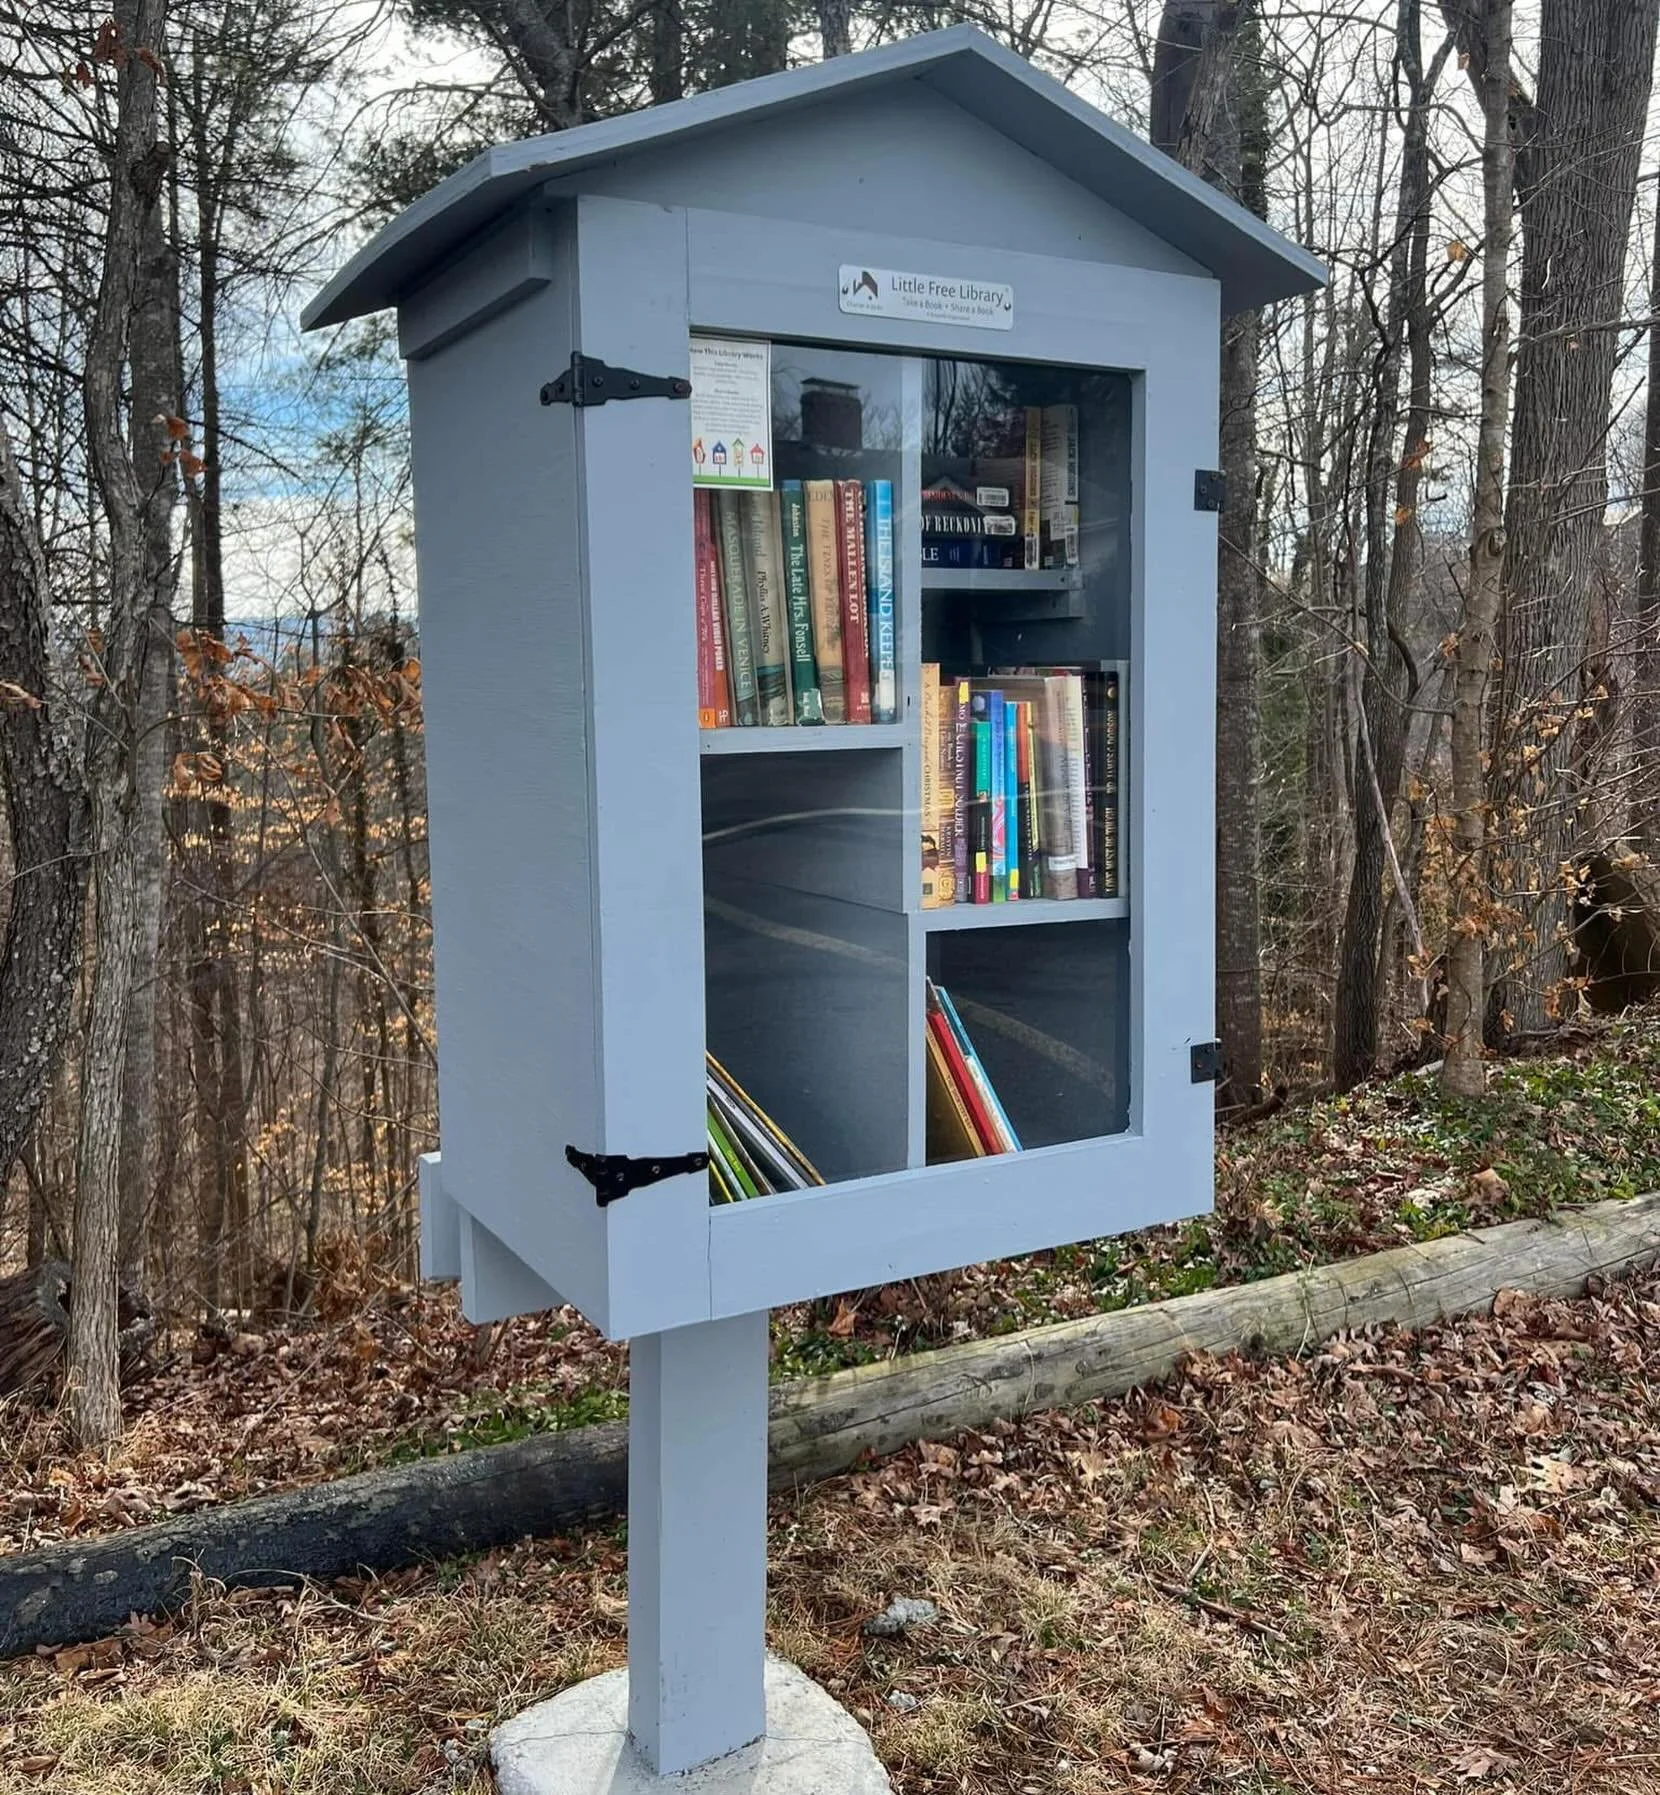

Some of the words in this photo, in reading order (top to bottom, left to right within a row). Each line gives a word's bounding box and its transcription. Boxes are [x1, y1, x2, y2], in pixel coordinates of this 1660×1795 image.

[891, 276, 926, 294] Little
[928, 281, 957, 298] Free
[959, 284, 1004, 308] Library
[925, 299, 942, 310] Book
[950, 302, 971, 313] Share
[704, 347, 718, 356] This
[719, 350, 741, 360] Library
[791, 502, 801, 538] Johnston
[844, 489, 855, 524] THE
[877, 518, 892, 557] THE
[934, 515, 982, 533] RECKONI
[725, 511, 746, 614] MASQUERADE
[790, 543, 804, 567] The
[846, 525, 859, 590] MALLEN
[756, 570, 769, 604] Phyllis
[791, 568, 805, 594] Late
[877, 557, 893, 616] ISLAND
[711, 593, 721, 621] DOLLAR
[792, 596, 808, 622] Mrs.
[848, 594, 860, 625] LOT
[713, 622, 722, 645] VIDEO
[735, 616, 746, 634] IN
[794, 623, 812, 662] Fonsell
[737, 638, 753, 690] VENICE
